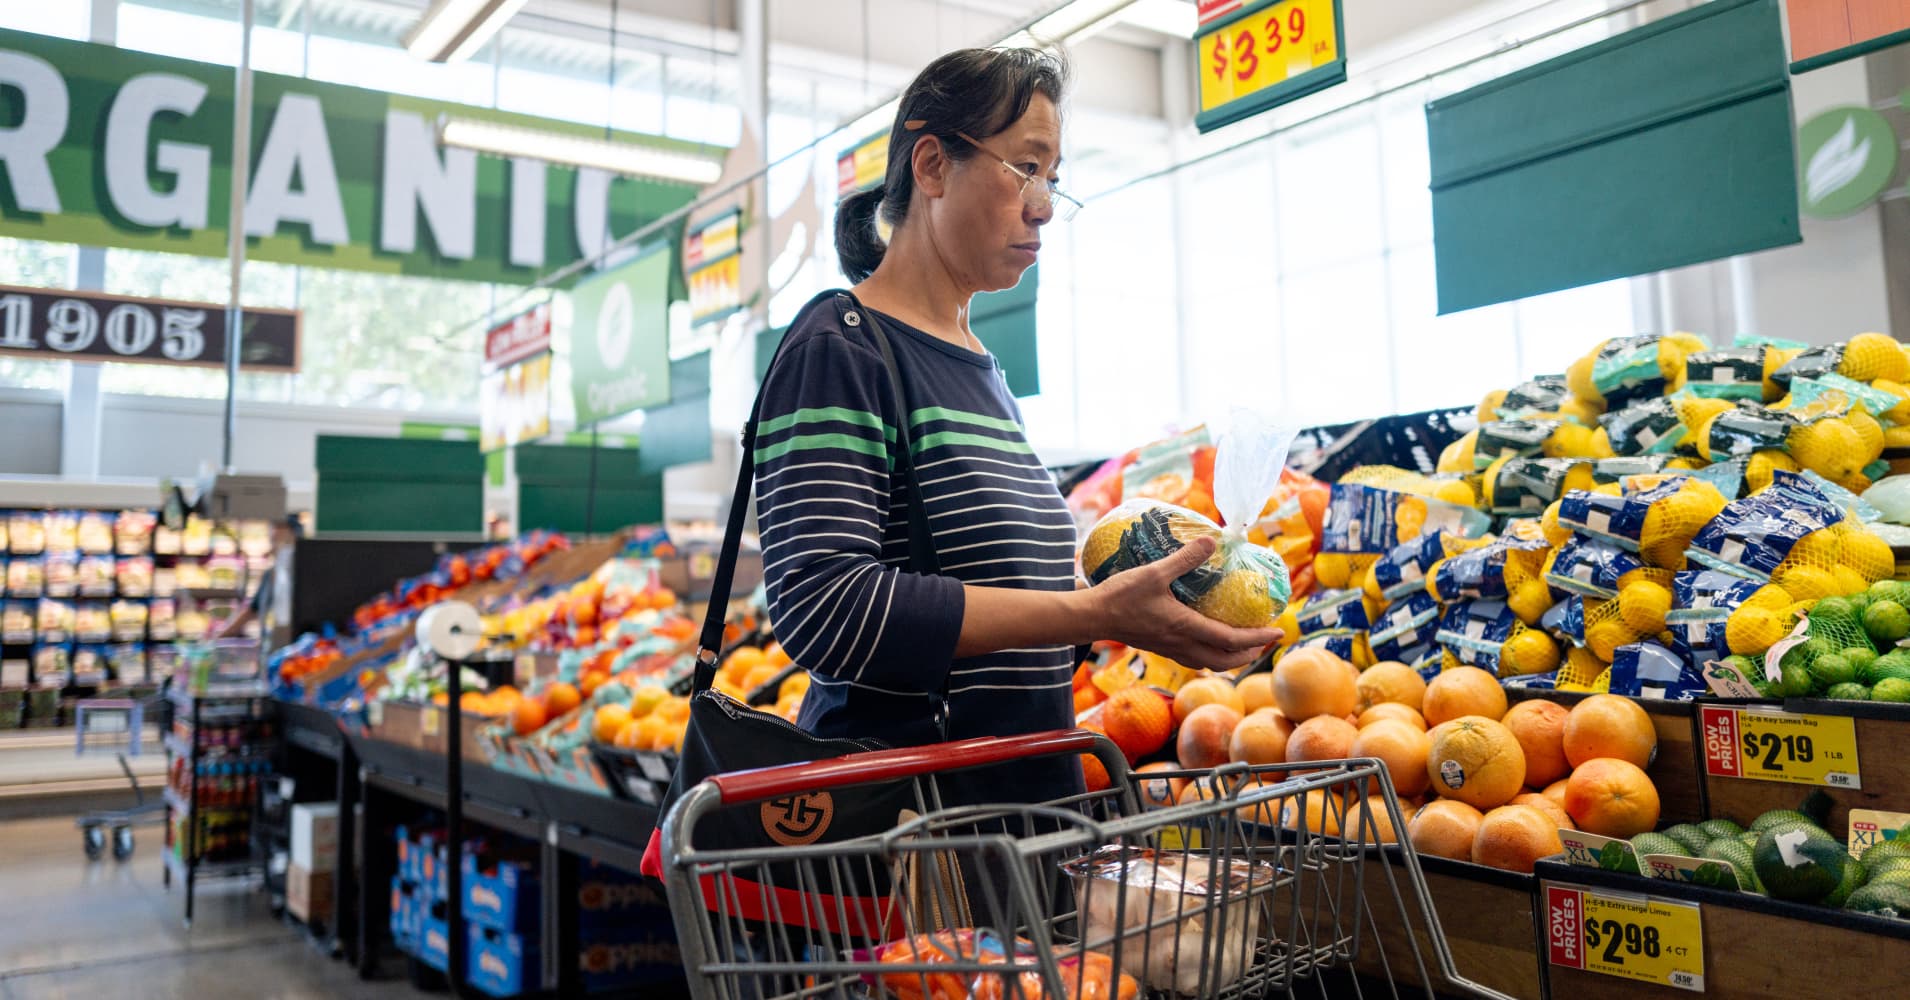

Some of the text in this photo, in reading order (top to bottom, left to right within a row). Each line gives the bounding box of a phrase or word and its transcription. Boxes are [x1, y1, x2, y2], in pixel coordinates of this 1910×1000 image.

[0, 294, 207, 361] 1905
[1779, 717, 1801, 725] Limes
[1803, 719, 1818, 727] Bag
[1707, 725, 1720, 760] LOW
[1718, 716, 1733, 770] PRICES
[1743, 731, 1814, 771] $219
[1567, 847, 1592, 862] XL
[1552, 906, 1564, 947] LOW
[1585, 899, 1671, 917] H-E-B Extra Large Limes
[1563, 897, 1577, 960] PRICES
[1585, 916, 1660, 965] $298
[1666, 946, 1688, 957] 4 CT
